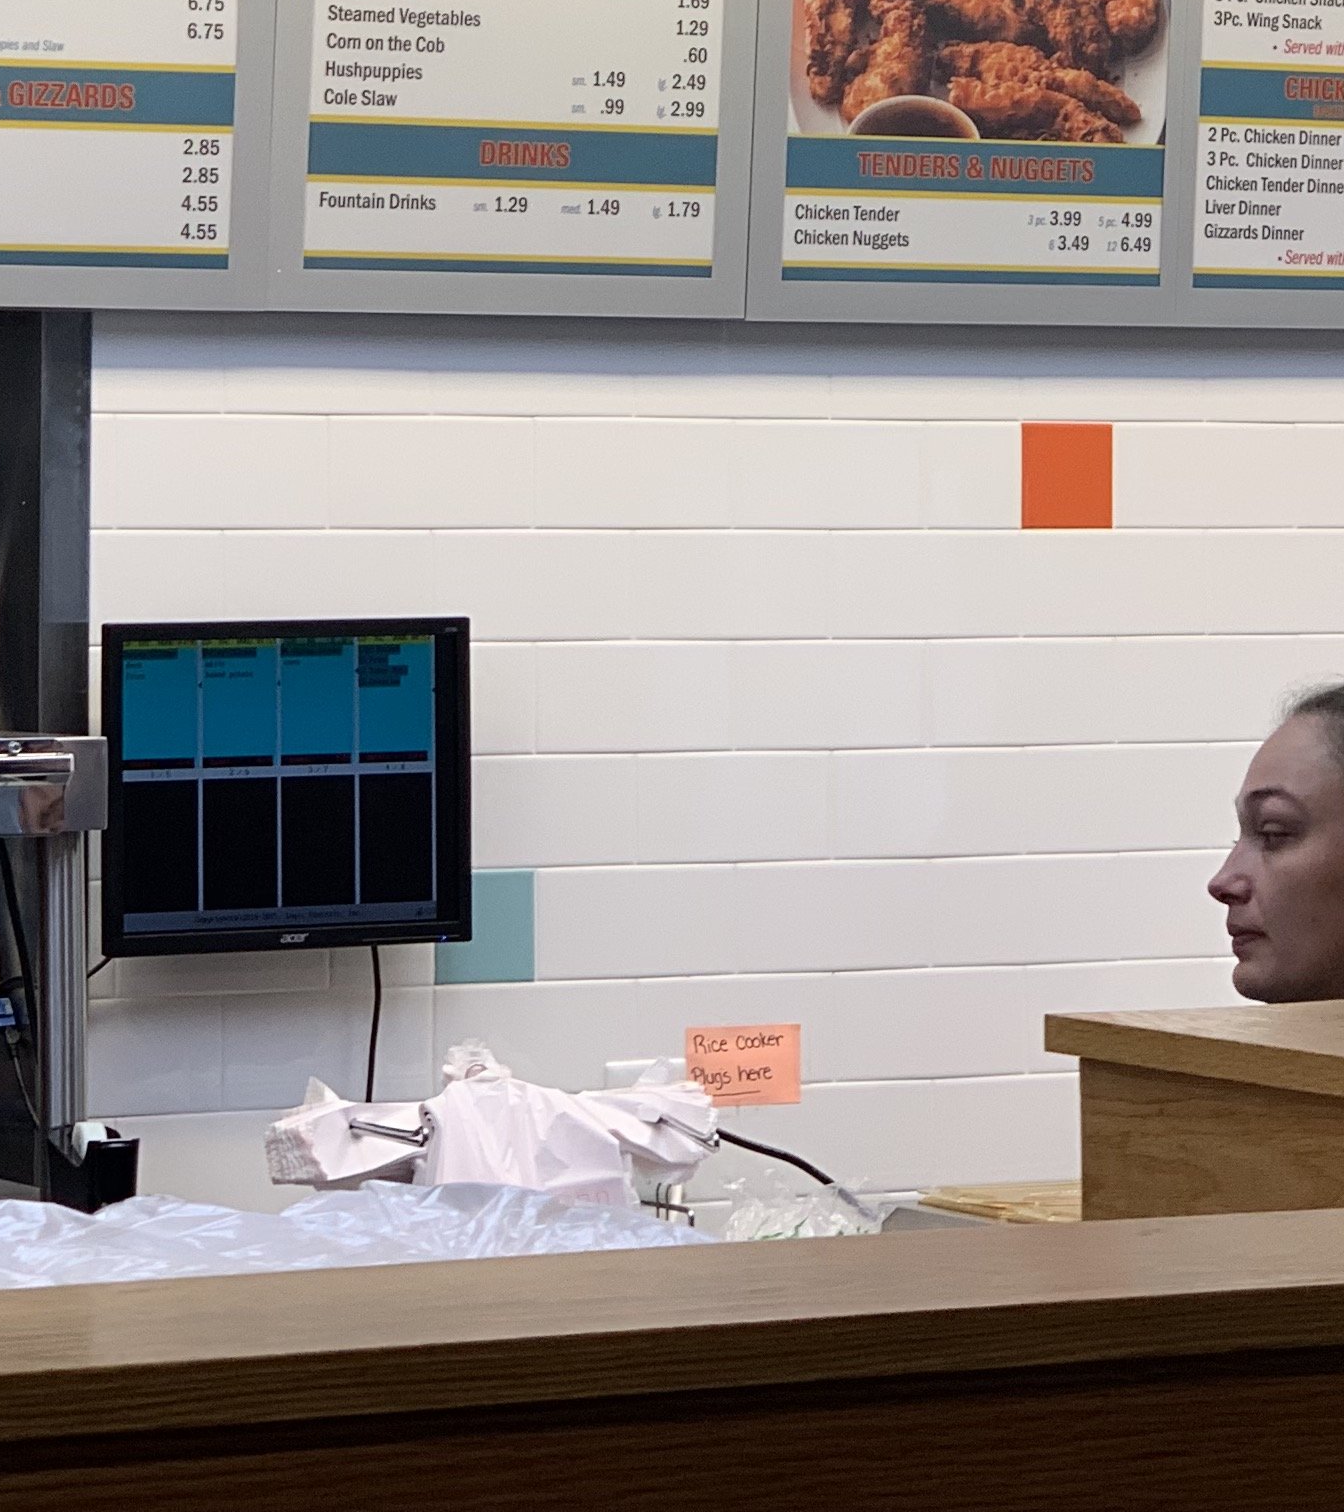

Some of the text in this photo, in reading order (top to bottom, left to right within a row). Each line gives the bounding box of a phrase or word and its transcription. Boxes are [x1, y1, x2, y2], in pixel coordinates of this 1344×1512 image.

[327, 4, 708, 36] Steamed Vegetables 1.29
[1213, 10, 1242, 27] 3Pc.
[1246, 11, 1279, 32] Wing
[1281, 13, 1322, 30] Snack
[7, 81, 133, 109] GIZZARDS
[480, 141, 568, 167] DRINKS
[181, 166, 219, 184] 2.85
[859, 152, 1093, 182] TENDERS & NUGGETS
[794, 203, 849, 220] Chicken
[852, 205, 900, 222] Tender
[1049, 211, 1082, 226] 3.99
[1121, 212, 1152, 228] 4.99
[1203, 223, 1258, 240] Gizzards
[1261, 224, 1304, 241] Dinner
[693, 1034, 729, 1054] Rice
[691, 1065, 773, 1091] Plugs here
